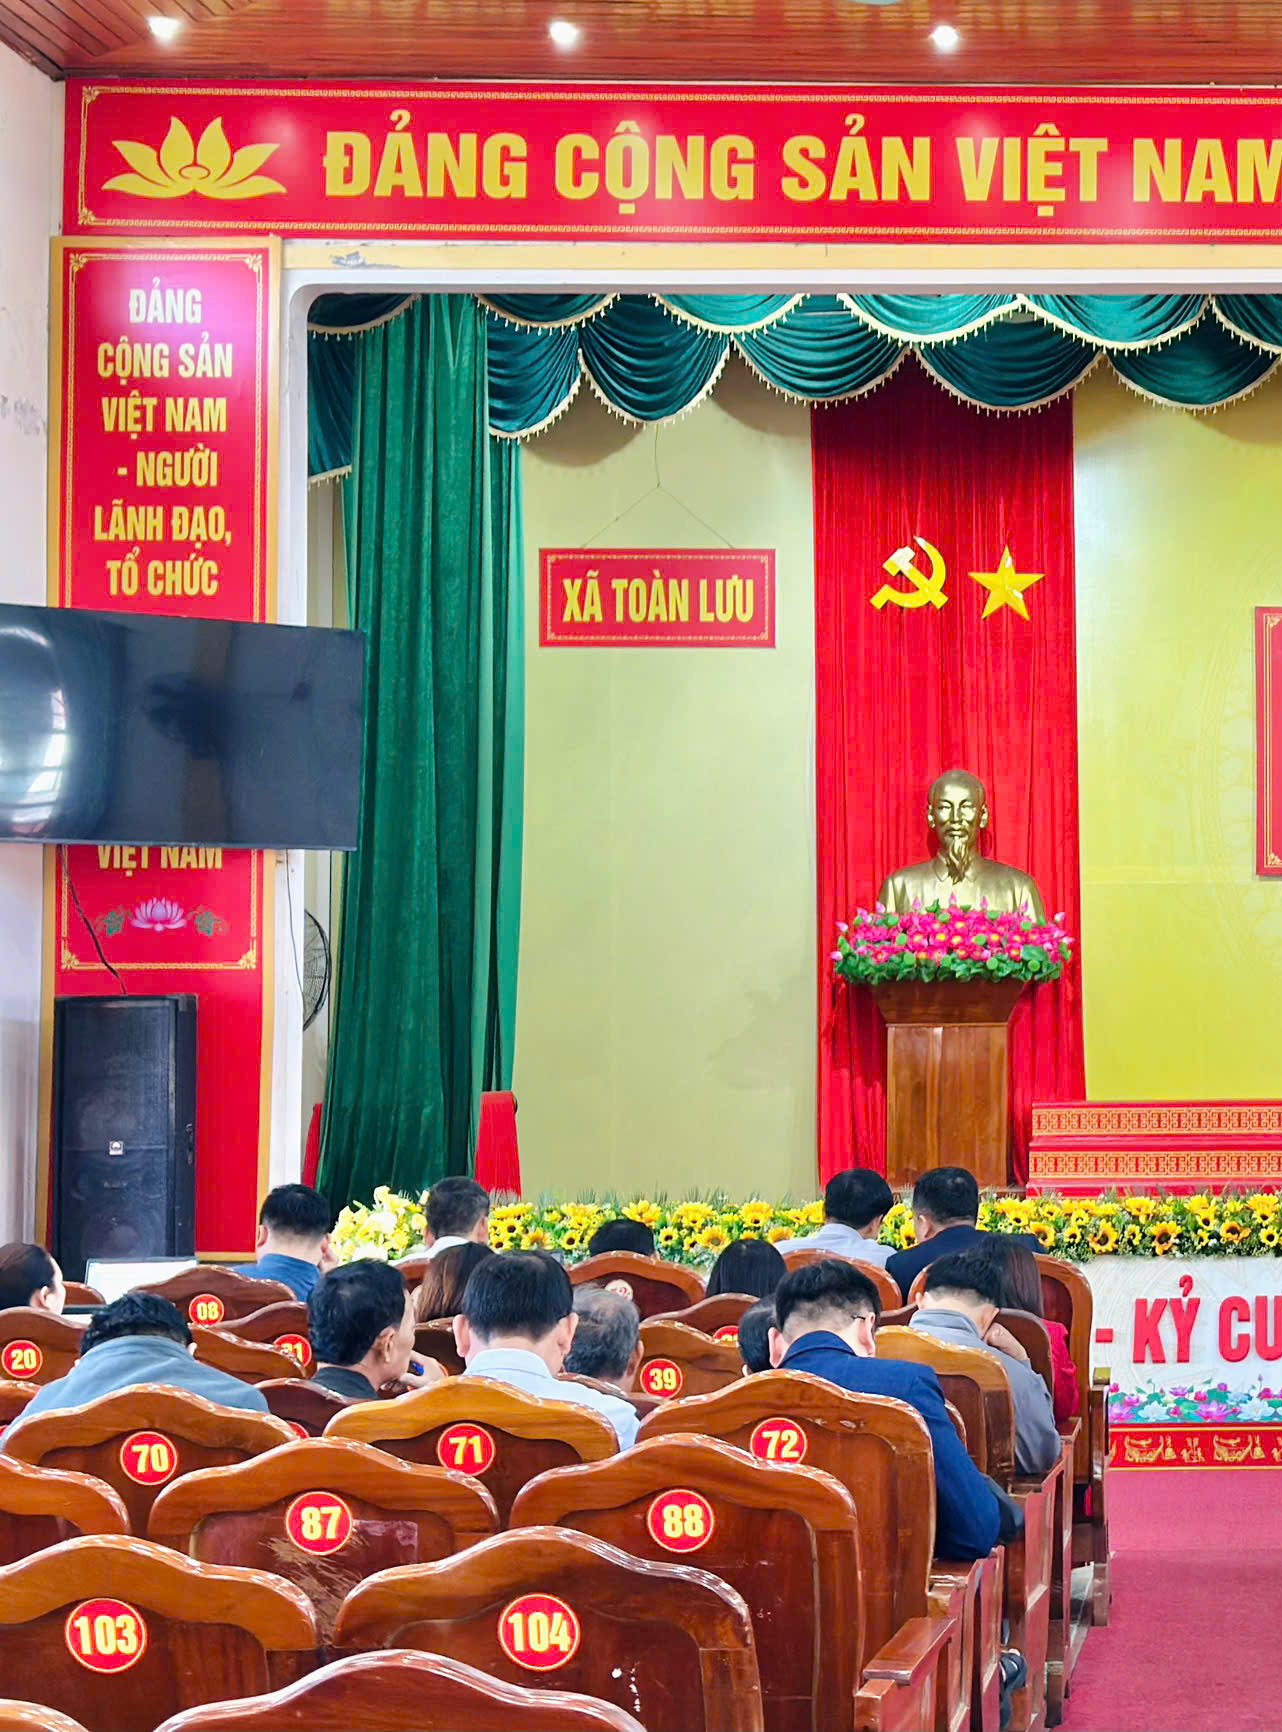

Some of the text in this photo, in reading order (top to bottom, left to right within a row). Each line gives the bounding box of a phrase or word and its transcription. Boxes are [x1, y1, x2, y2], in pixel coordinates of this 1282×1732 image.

[322, 108, 528, 200] ĐẢNG
[554, 119, 755, 216] CỘNG
[781, 113, 931, 202] SẢN
[955, 123, 1109, 217] VIỆT
[128, 276, 203, 325] ĐẢNG
[96, 330, 233, 386] CỘNG SẢN
[101, 389, 227, 440] VIỆT NAM
[136, 442, 218, 488] NGƯỜI
[94, 498, 232, 549] LÃNH ĐẠO,
[106, 545, 219, 596] TỔ CHỨC
[562, 569, 754, 623] XÃ TOÀN LƯU
[196, 1301, 219, 1321] 08
[1132, 1274, 1200, 1363] KỶ
[10, 1348, 37, 1370] 20
[649, 1367, 677, 1391] 39
[131, 1443, 170, 1473] 70
[449, 1435, 483, 1465] 71
[761, 1429, 800, 1459] 72
[300, 1505, 342, 1541] 87
[662, 1503, 705, 1539] 88
[72, 1614, 138, 1656] 103
[507, 1611, 572, 1653] 104
